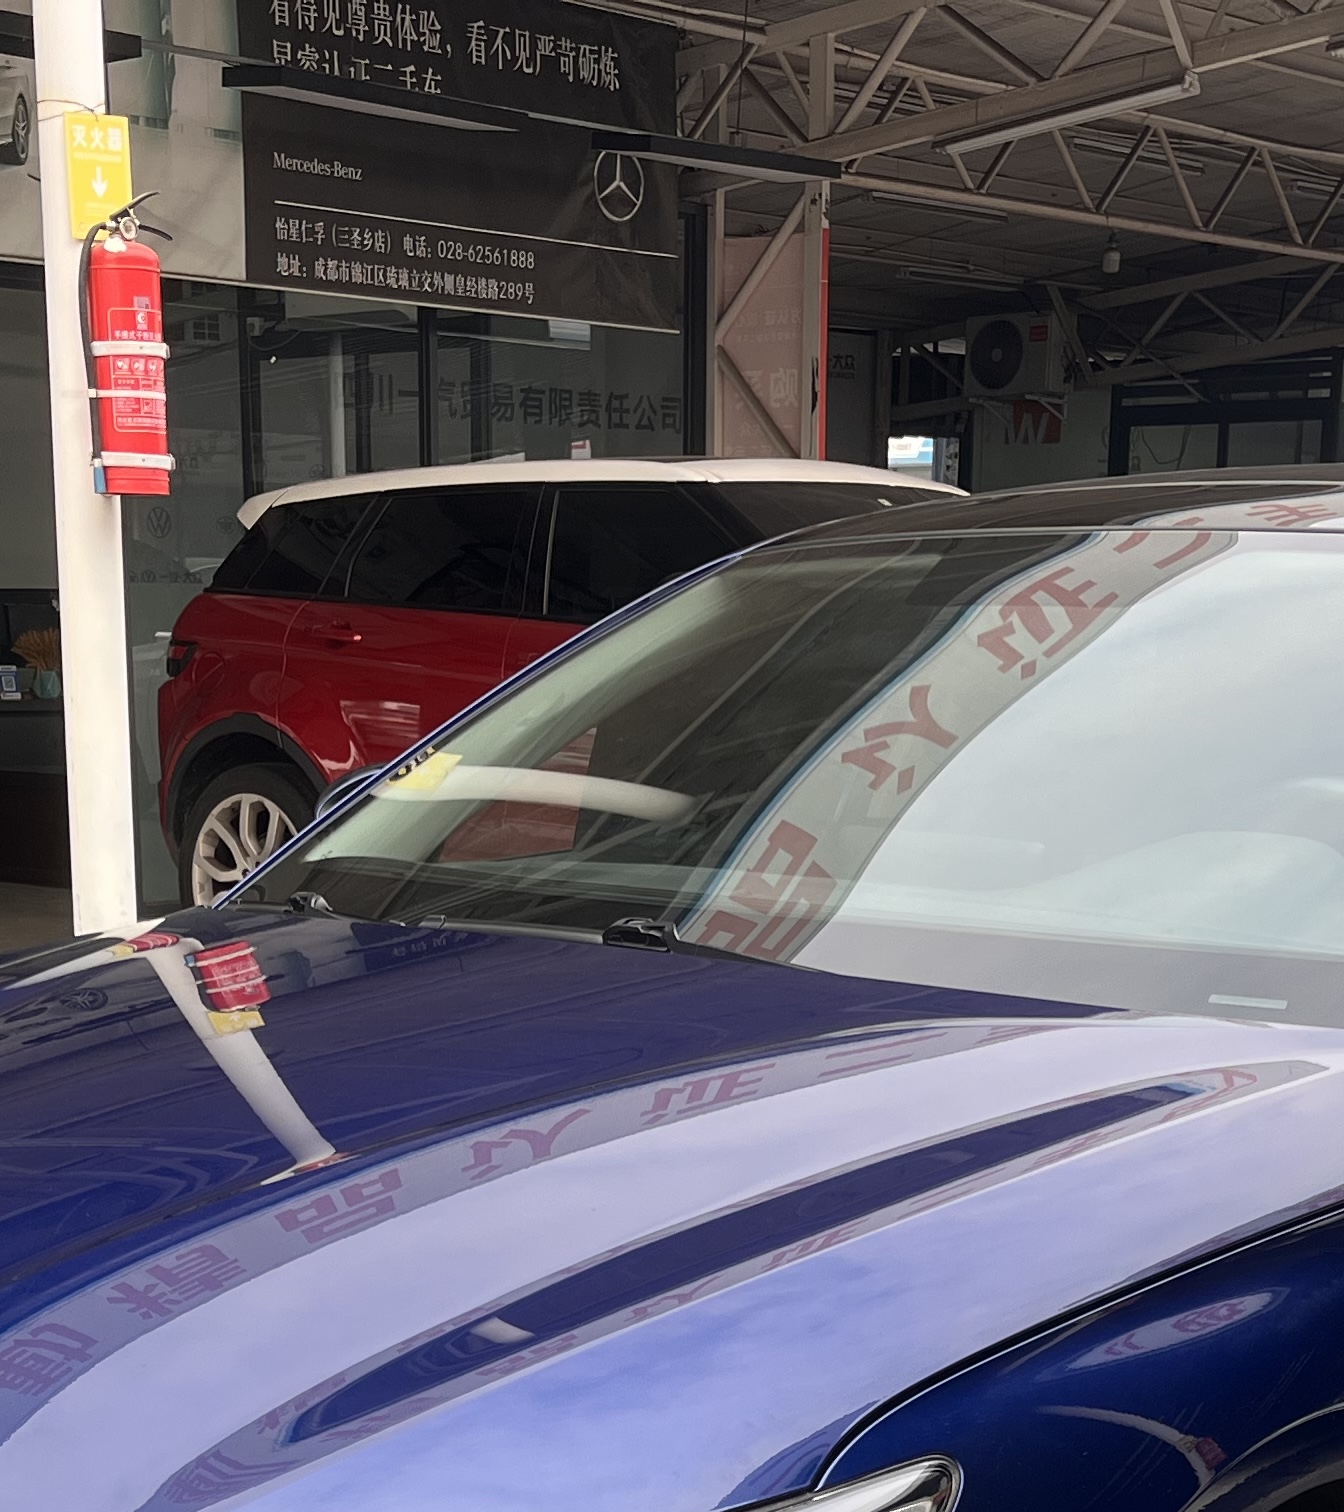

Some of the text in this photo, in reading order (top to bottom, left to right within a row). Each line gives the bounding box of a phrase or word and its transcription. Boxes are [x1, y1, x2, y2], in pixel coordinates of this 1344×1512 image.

[72, 124, 123, 152] 灭火器
[272, 152, 363, 181] Mercedes-Benz
